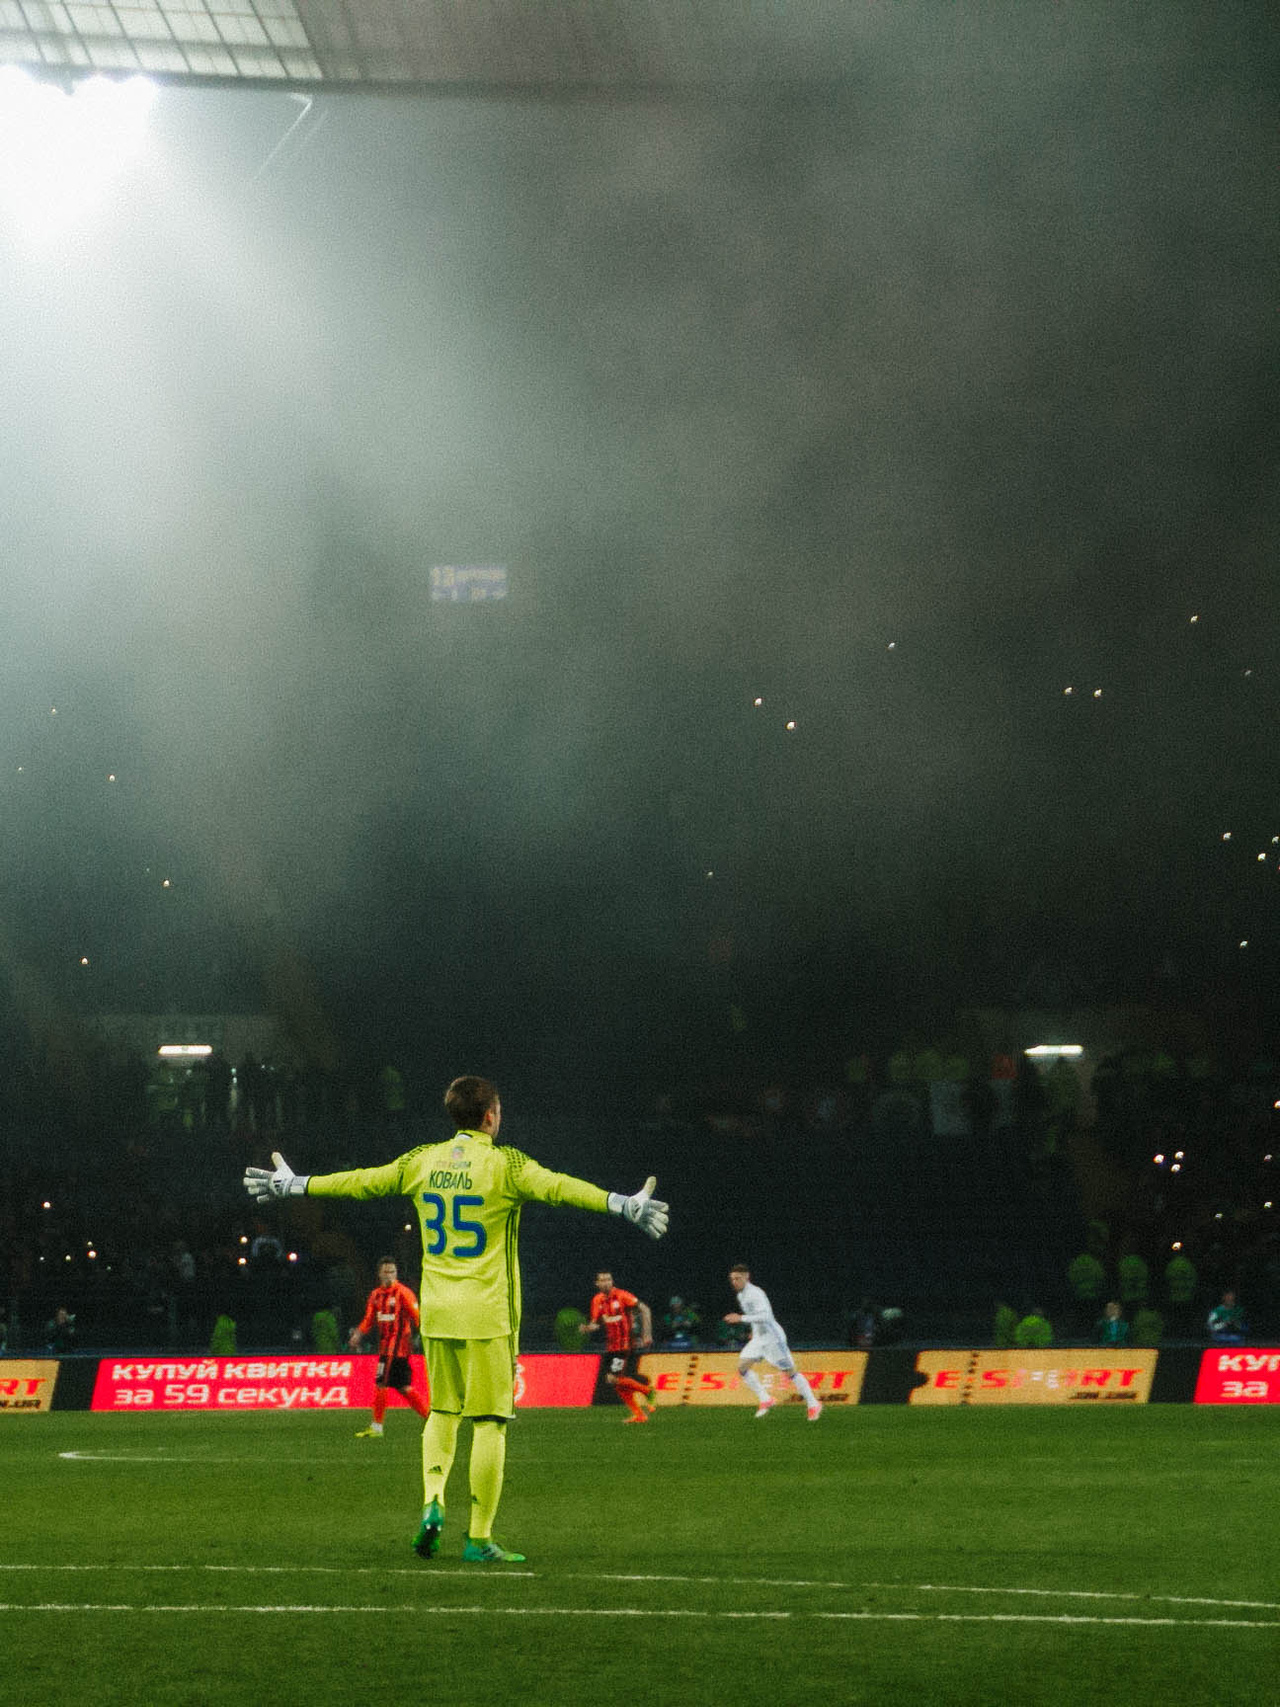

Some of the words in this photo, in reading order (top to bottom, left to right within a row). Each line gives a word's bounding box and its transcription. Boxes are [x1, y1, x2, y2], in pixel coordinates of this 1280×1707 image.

[423, 1193, 487, 1258] 35
[112, 1360, 218, 1380] КУПУЙ
[224, 1361, 352, 1380] КВИТКИ
[114, 1388, 154, 1405] за
[164, 1384, 210, 1405] 59
[218, 1385, 349, 1409] секунд
